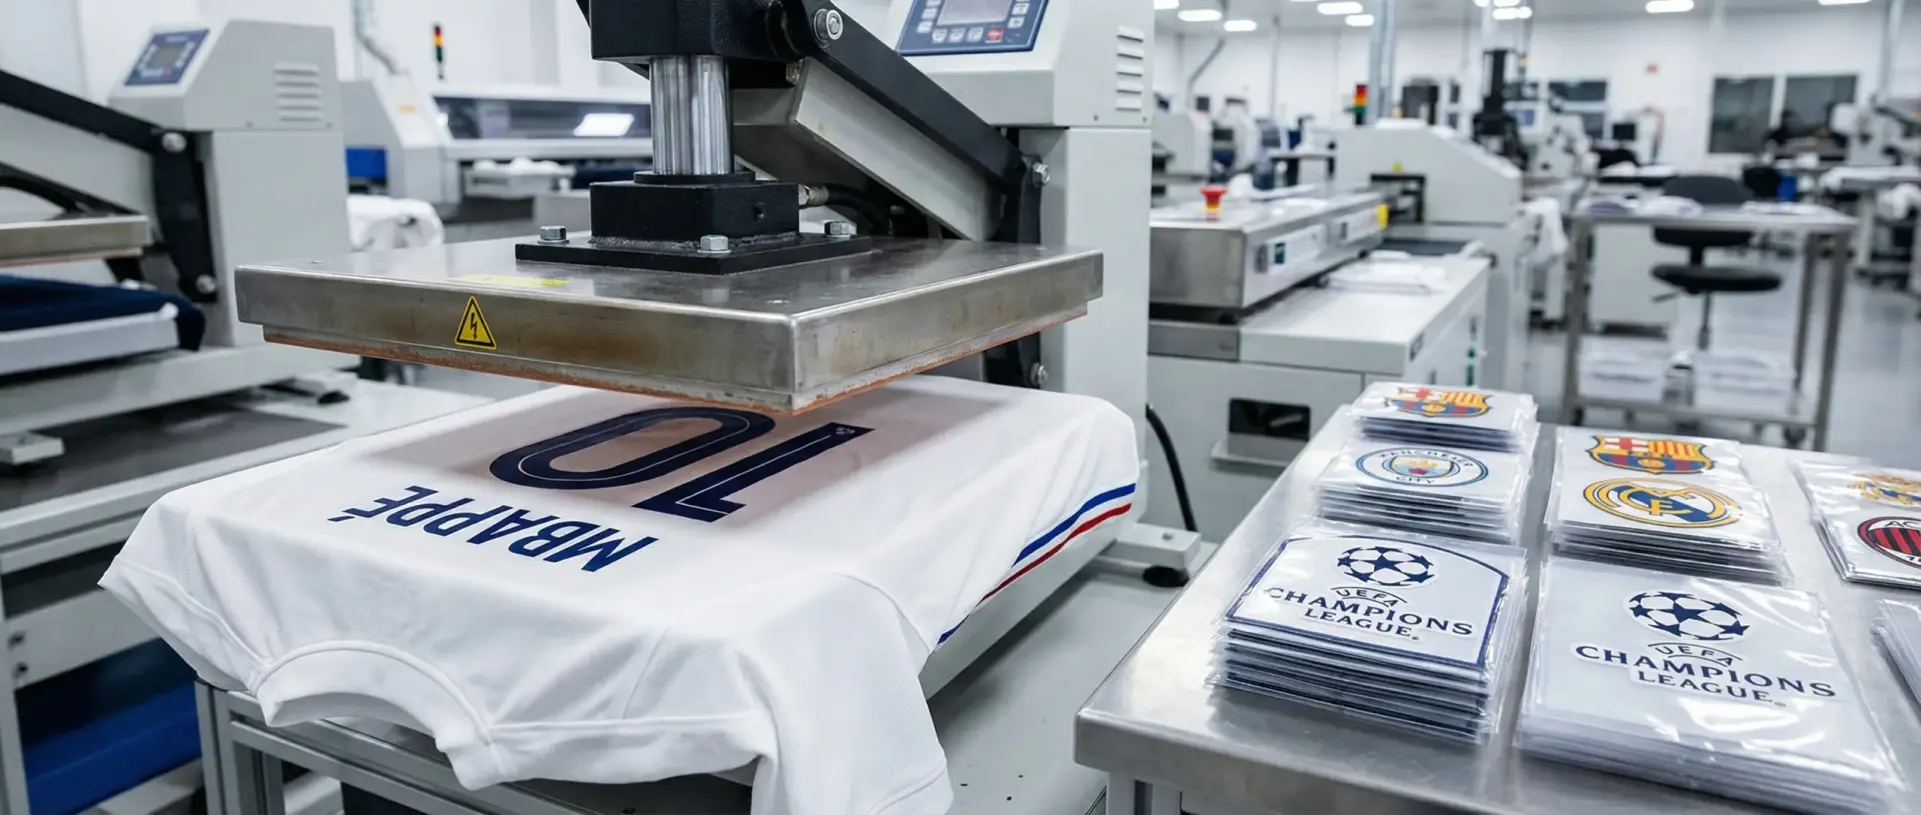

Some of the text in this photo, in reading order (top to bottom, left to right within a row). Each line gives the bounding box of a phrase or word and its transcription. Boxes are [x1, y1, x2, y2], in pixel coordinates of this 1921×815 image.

[490, 407, 875, 522] 10
[1396, 476, 1435, 484] CITY
[328, 485, 659, 572] MBAPPÉ
[1264, 587, 1473, 635] CHAMPIONS
[1336, 589, 1399, 607] UEFA
[1304, 608, 1412, 637] LEAGUE
[1576, 646, 1836, 697] CHAMPIONS
[1655, 645, 1733, 666] UEFA
[1638, 671, 1773, 703] LEAGUE
